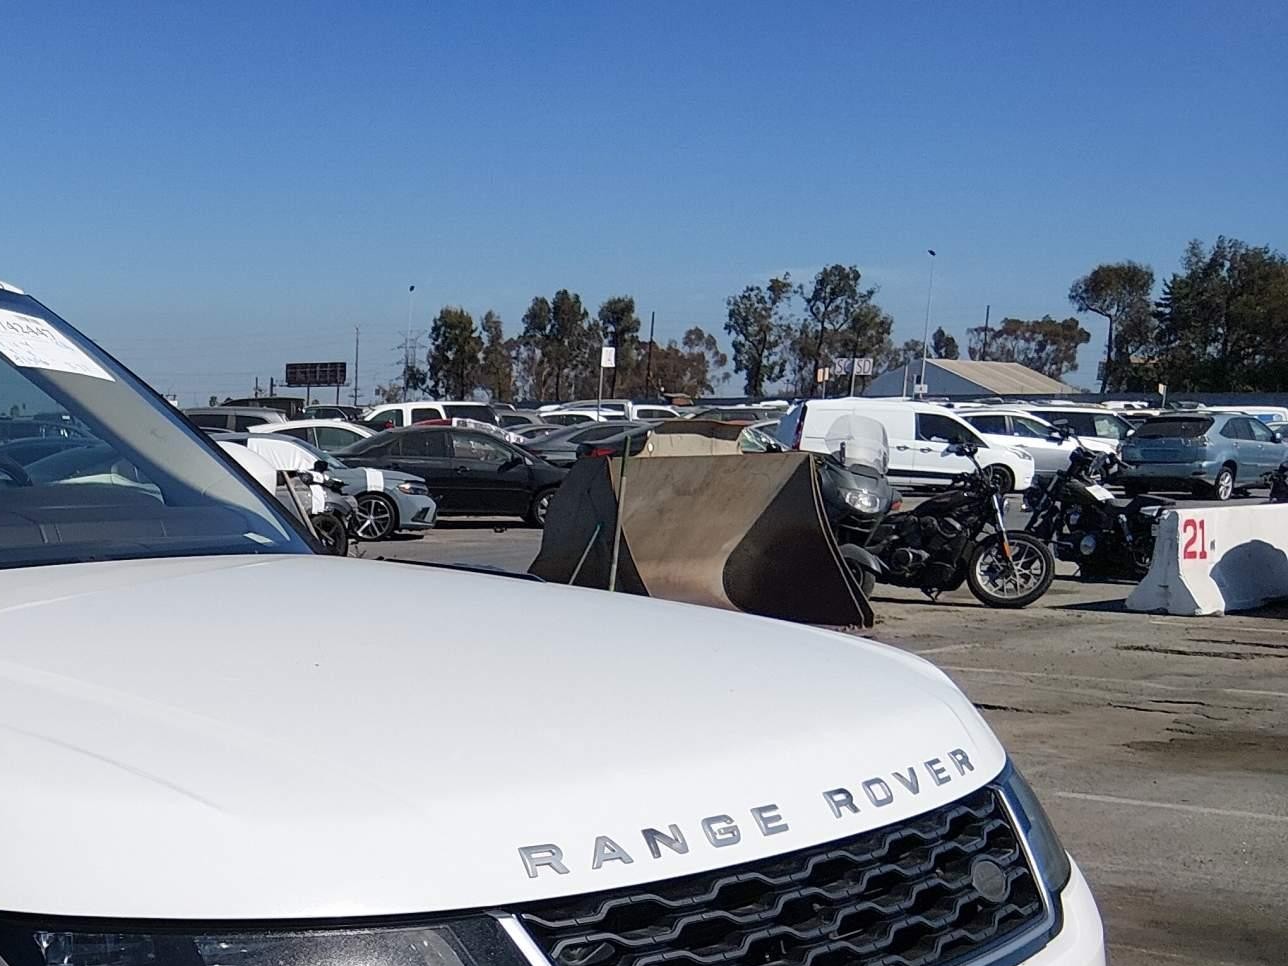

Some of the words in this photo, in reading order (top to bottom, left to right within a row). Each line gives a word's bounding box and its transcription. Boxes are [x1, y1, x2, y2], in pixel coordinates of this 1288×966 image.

[1183, 518, 1207, 560] 21
[517, 803, 790, 879] RANGE
[822, 748, 975, 819] ROVER
